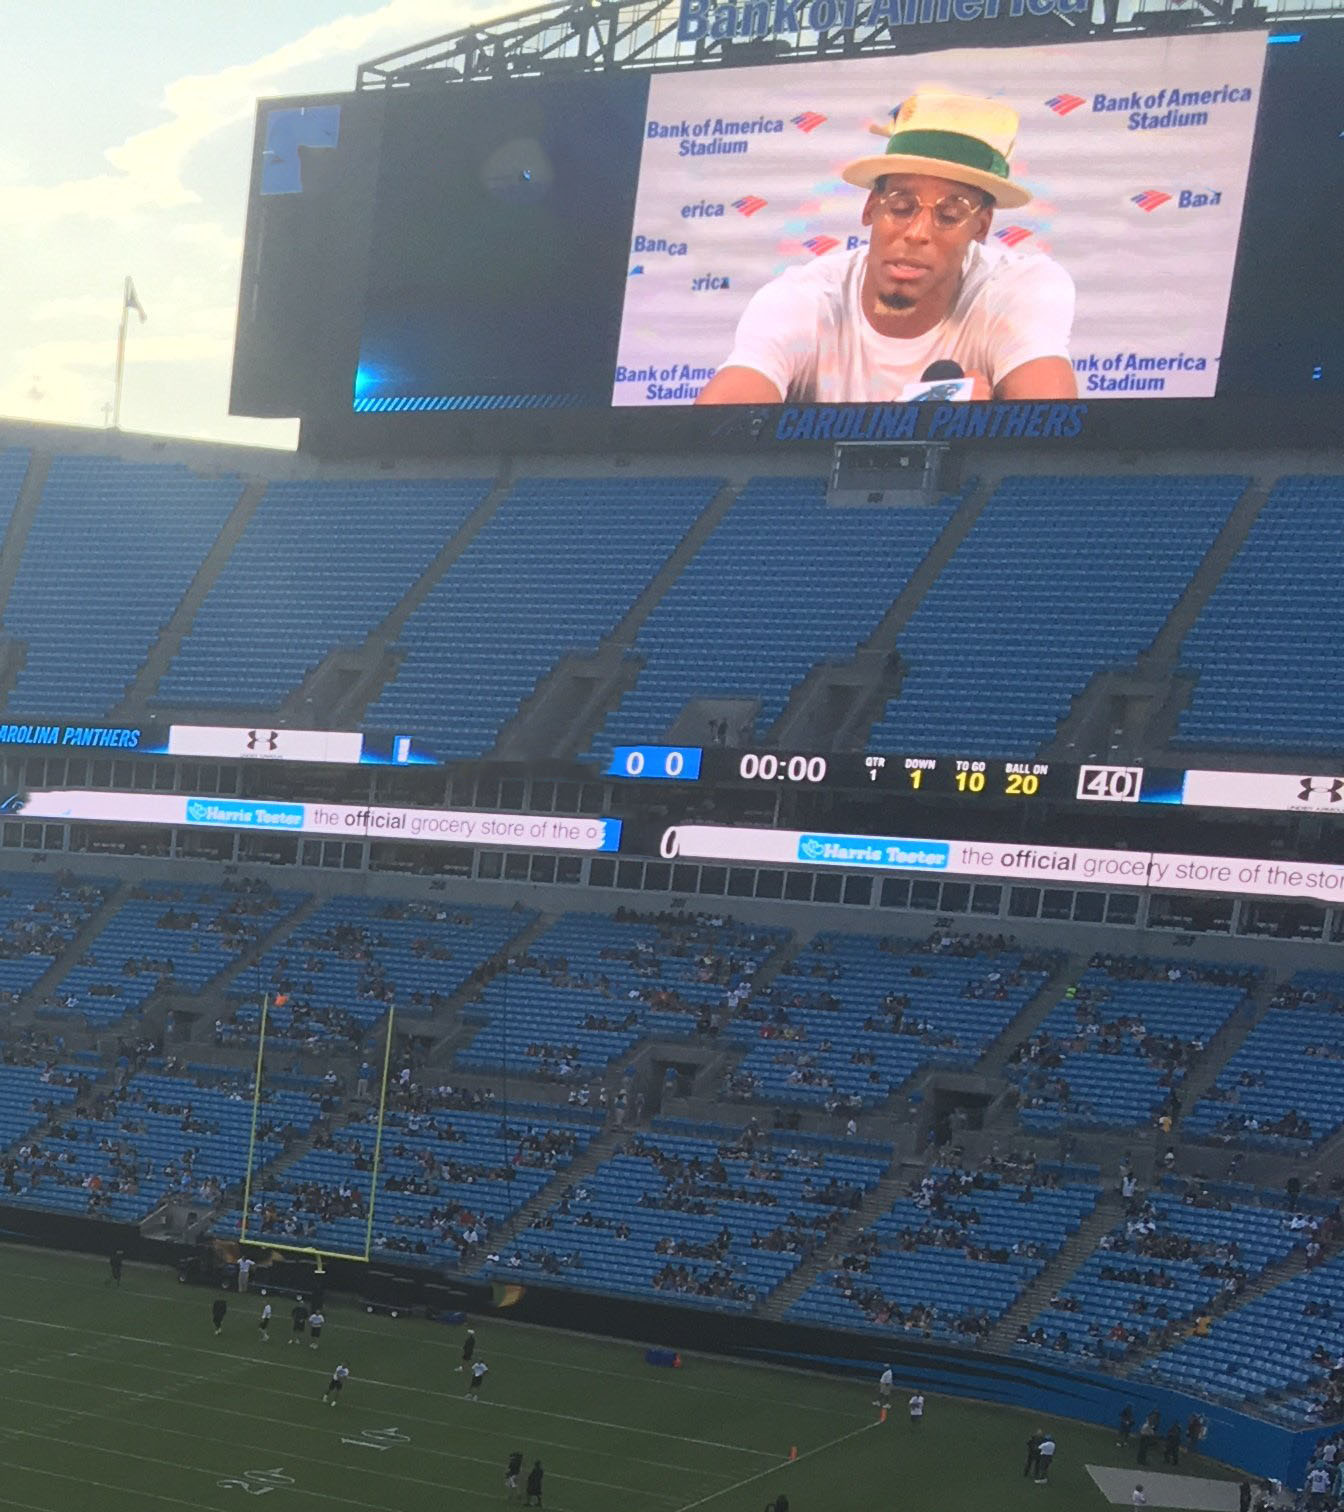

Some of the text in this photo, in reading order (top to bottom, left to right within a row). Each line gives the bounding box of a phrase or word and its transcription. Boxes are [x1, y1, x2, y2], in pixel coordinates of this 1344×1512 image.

[678, 0, 802, 41] Bank
[1092, 85, 1252, 112] Bank of America
[648, 116, 784, 138] Bank of America
[1128, 110, 1208, 130] Stadium
[678, 138, 748, 156] Stadium
[1102, 352, 1207, 371] of America
[616, 366, 657, 383] Bank
[660, 364, 677, 380] of
[1086, 374, 1165, 391] Stadium
[776, 404, 1088, 440] CAROLINA PANTHERS
[62, 727, 141, 747] PANTHERS
[626, 751, 684, 776] 0 0
[740, 753, 826, 782] 00:00
[865, 757, 885, 767] QTR
[905, 758, 936, 770] DOWN
[956, 761, 986, 772] TO GO
[1006, 763, 1048, 775] BALL ON
[869, 769, 877, 781] 1
[910, 770, 921, 789] 1
[955, 772, 985, 792] 10
[1005, 774, 1038, 795] 20
[1087, 771, 1133, 797] 40
[207, 807, 253, 822] Harris
[256, 809, 302, 825] Teeter
[314, 808, 339, 825] the
[345, 811, 406, 830] official
[411, 817, 475, 836] grocery
[481, 819, 525, 837] store
[529, 820, 548, 838] of
[552, 821, 581, 839] the
[824, 846, 881, 861] Harris
[886, 848, 945, 865] Teeter
[962, 848, 994, 866] the
[1001, 850, 1078, 871] official
[1084, 857, 1169, 881] grocery
[1175, 862, 1232, 882] store
[1239, 864, 1263, 884] of
[1267, 866, 1302, 886] the
